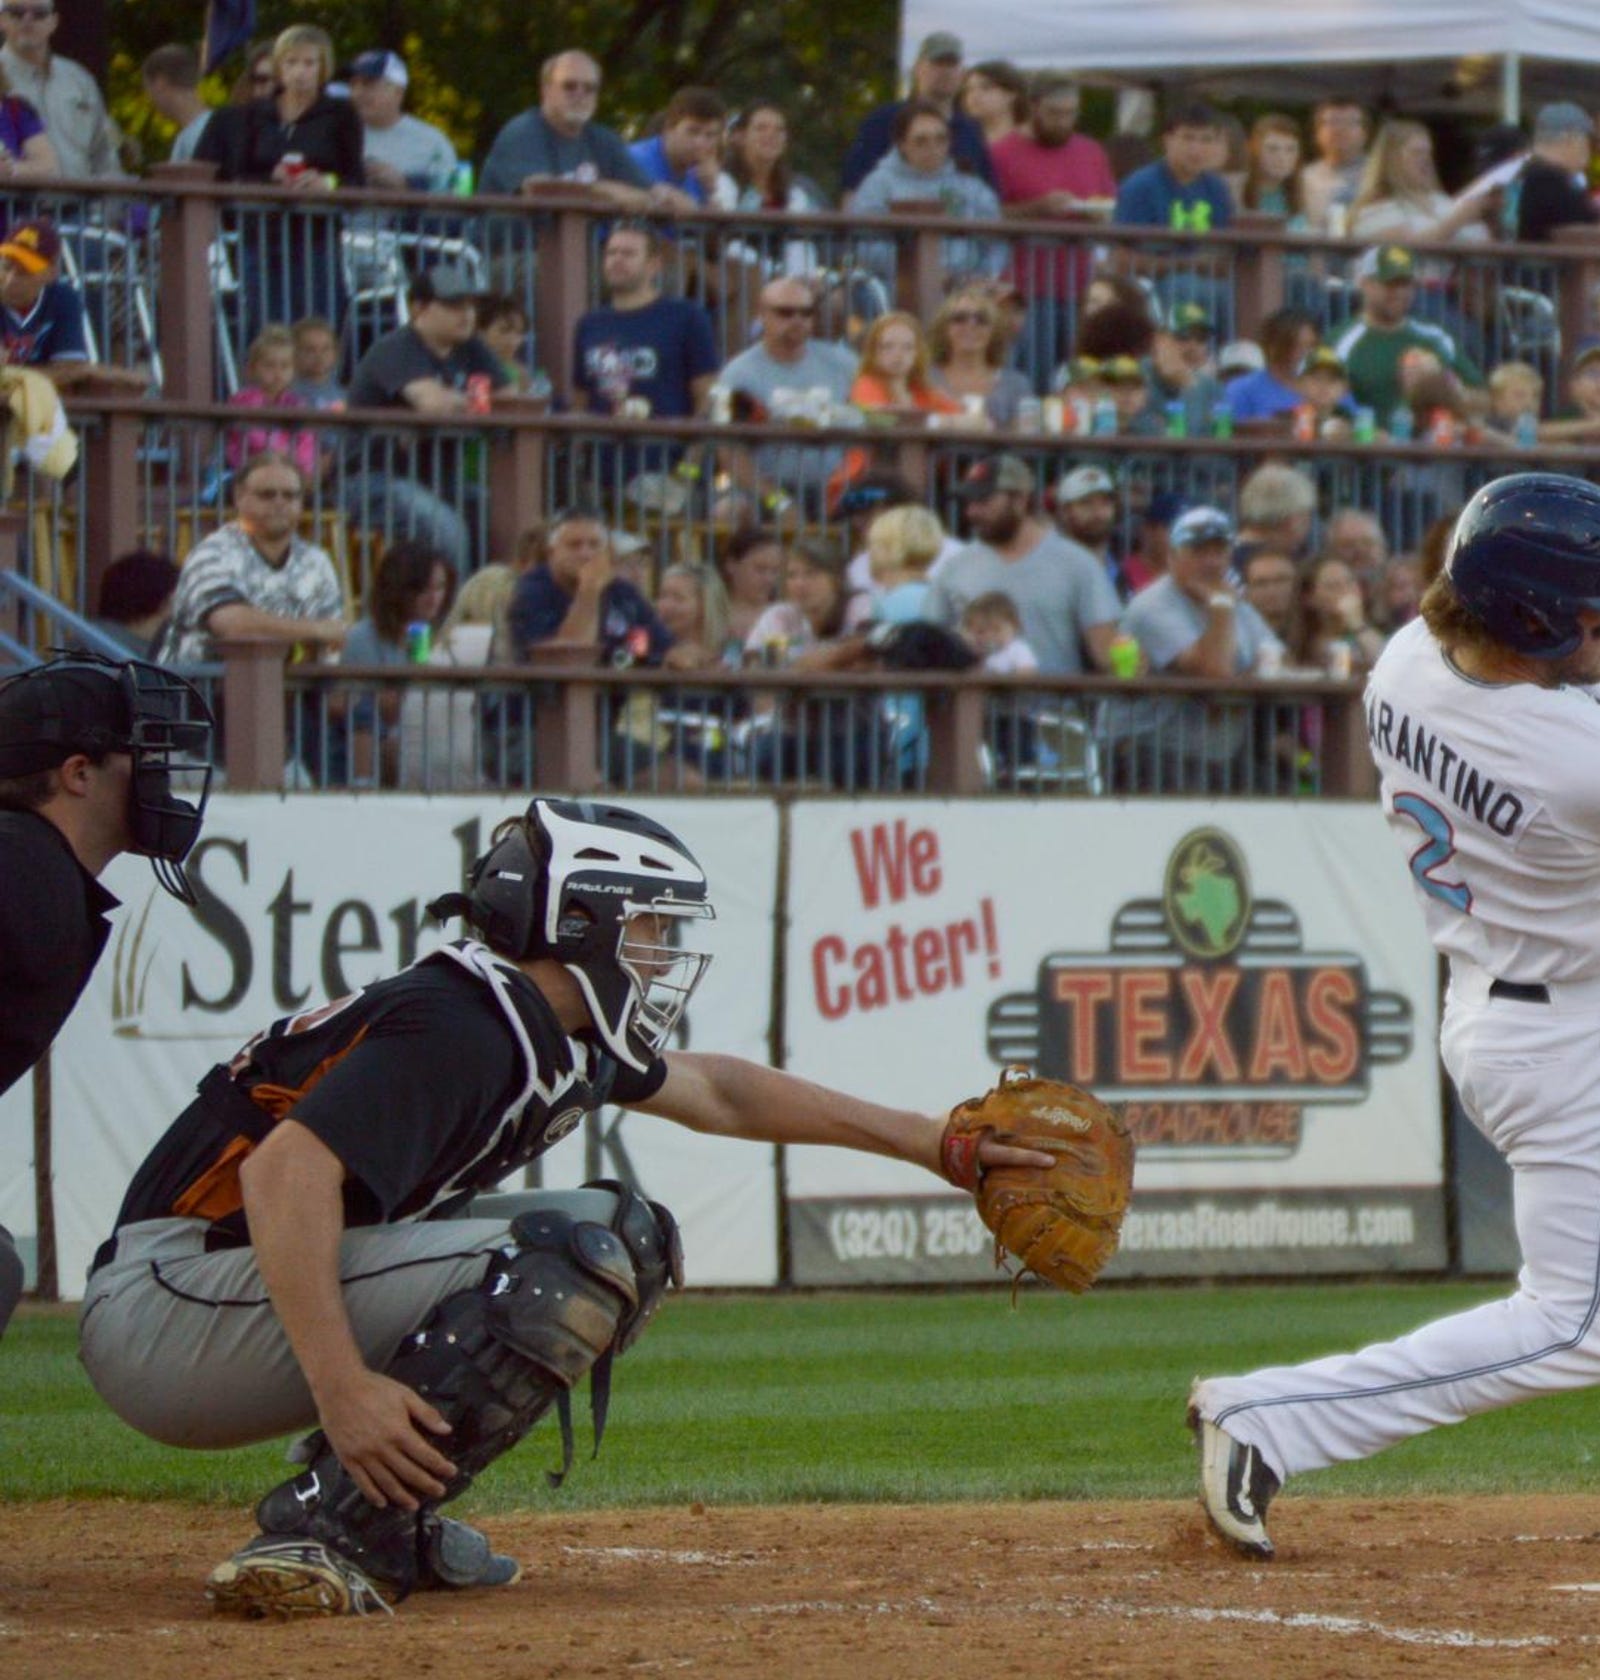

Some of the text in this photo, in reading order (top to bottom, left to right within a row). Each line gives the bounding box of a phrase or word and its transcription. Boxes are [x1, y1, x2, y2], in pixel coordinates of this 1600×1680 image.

[851, 819, 942, 910] We
[1392, 791, 1473, 917] 2
[812, 897, 1002, 1021] Cater!
[1054, 967, 1361, 1083] TEXAS
[831, 1208, 918, 1260] (320)
[1118, 1200, 1413, 1250] exasRoadhouse.com
